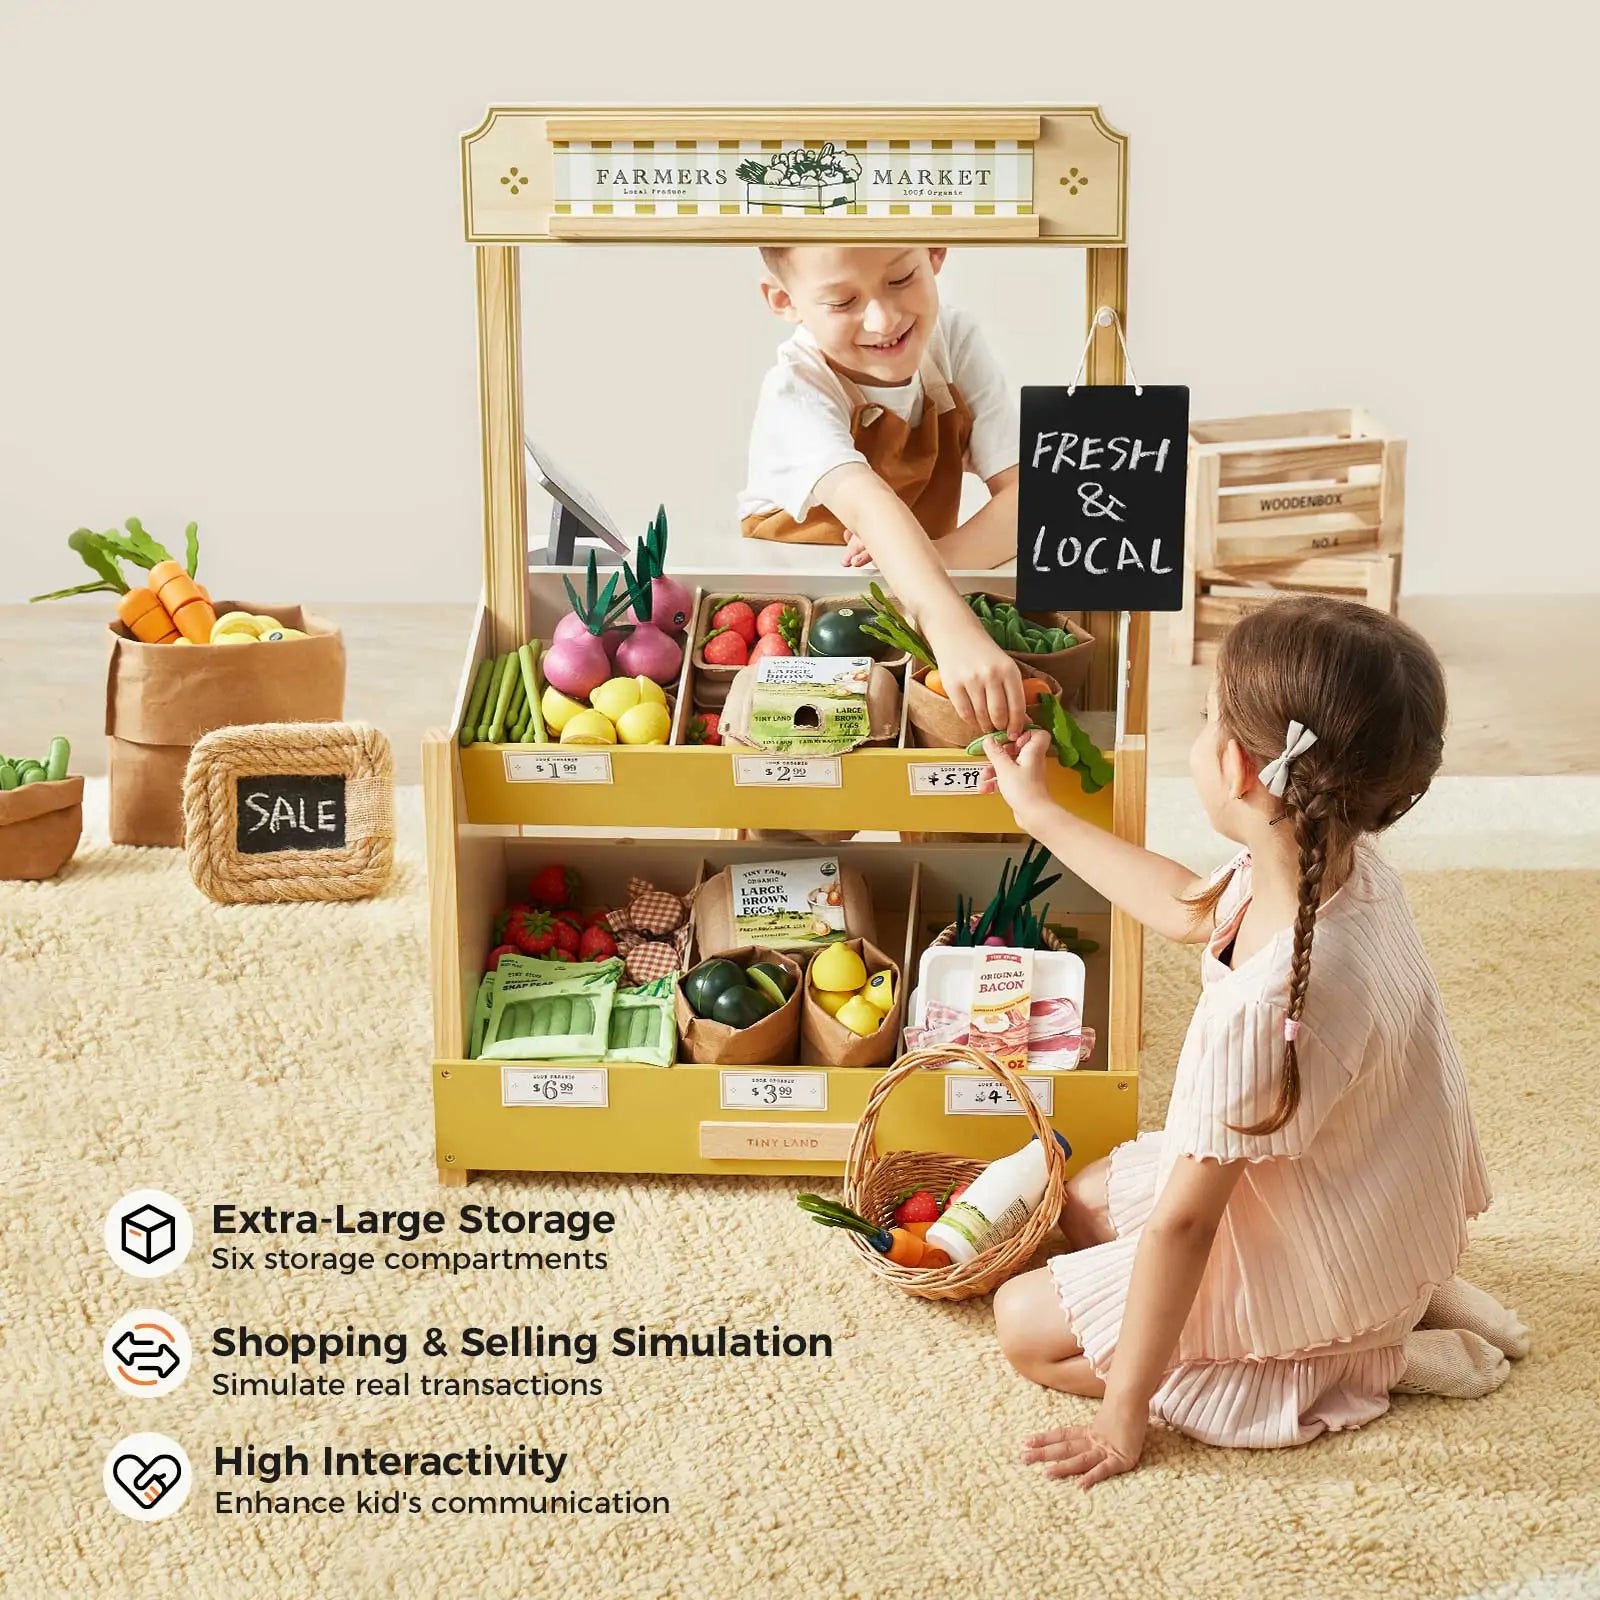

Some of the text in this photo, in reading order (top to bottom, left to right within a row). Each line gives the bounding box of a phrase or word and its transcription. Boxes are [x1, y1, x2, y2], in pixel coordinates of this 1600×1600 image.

[596, 169, 991, 185] FARMERS MARKET
[903, 189, 964, 197] 100% Organic
[1032, 431, 1171, 474] FRESH
[1077, 481, 1127, 522] &
[1260, 493, 1343, 511] WOODENBOX
[1032, 525, 1174, 575] LOCAL
[834, 714, 863, 722] BROWN
[245, 792, 337, 835] SALE
[743, 868, 787, 878] TINY FARM
[741, 885, 785, 897] LARGE
[742, 894, 789, 906] BROWN
[743, 905, 775, 915] EGGS
[980, 970, 1025, 981] ORIGINAL
[979, 979, 1025, 993] BACON
[747, 1138, 819, 1148] TINY LAND
